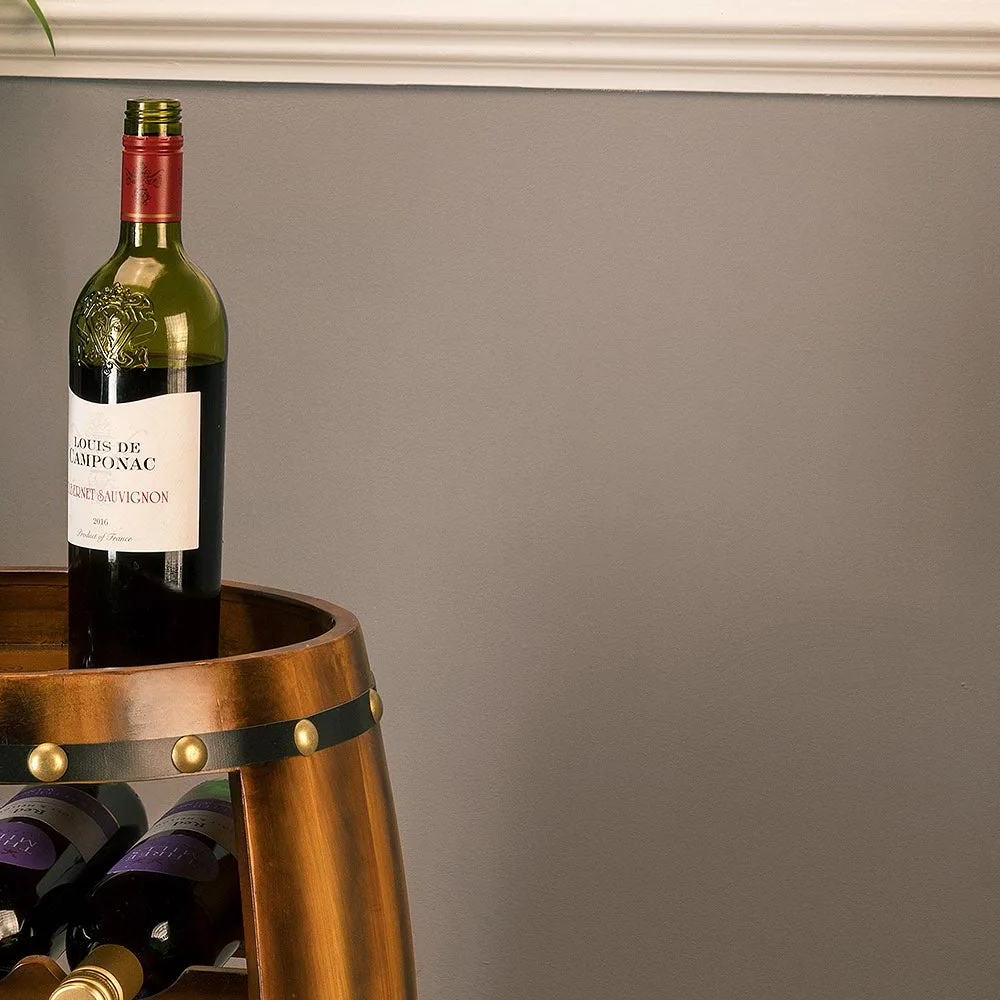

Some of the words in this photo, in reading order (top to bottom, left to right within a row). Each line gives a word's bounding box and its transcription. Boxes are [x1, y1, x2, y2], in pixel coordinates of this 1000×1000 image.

[74, 436, 111, 452] LOUIS
[118, 441, 141, 454] DE
[69, 447, 156, 471] CAMPONAC
[97, 489, 169, 504] SAUVIGNON
[92, 517, 109, 526] 2016
[76, 528, 98, 540] Product
[98, 532, 106, 543] of
[106, 532, 134, 543] France
[13, 808, 47, 816] Red
[173, 821, 205, 829] Red
